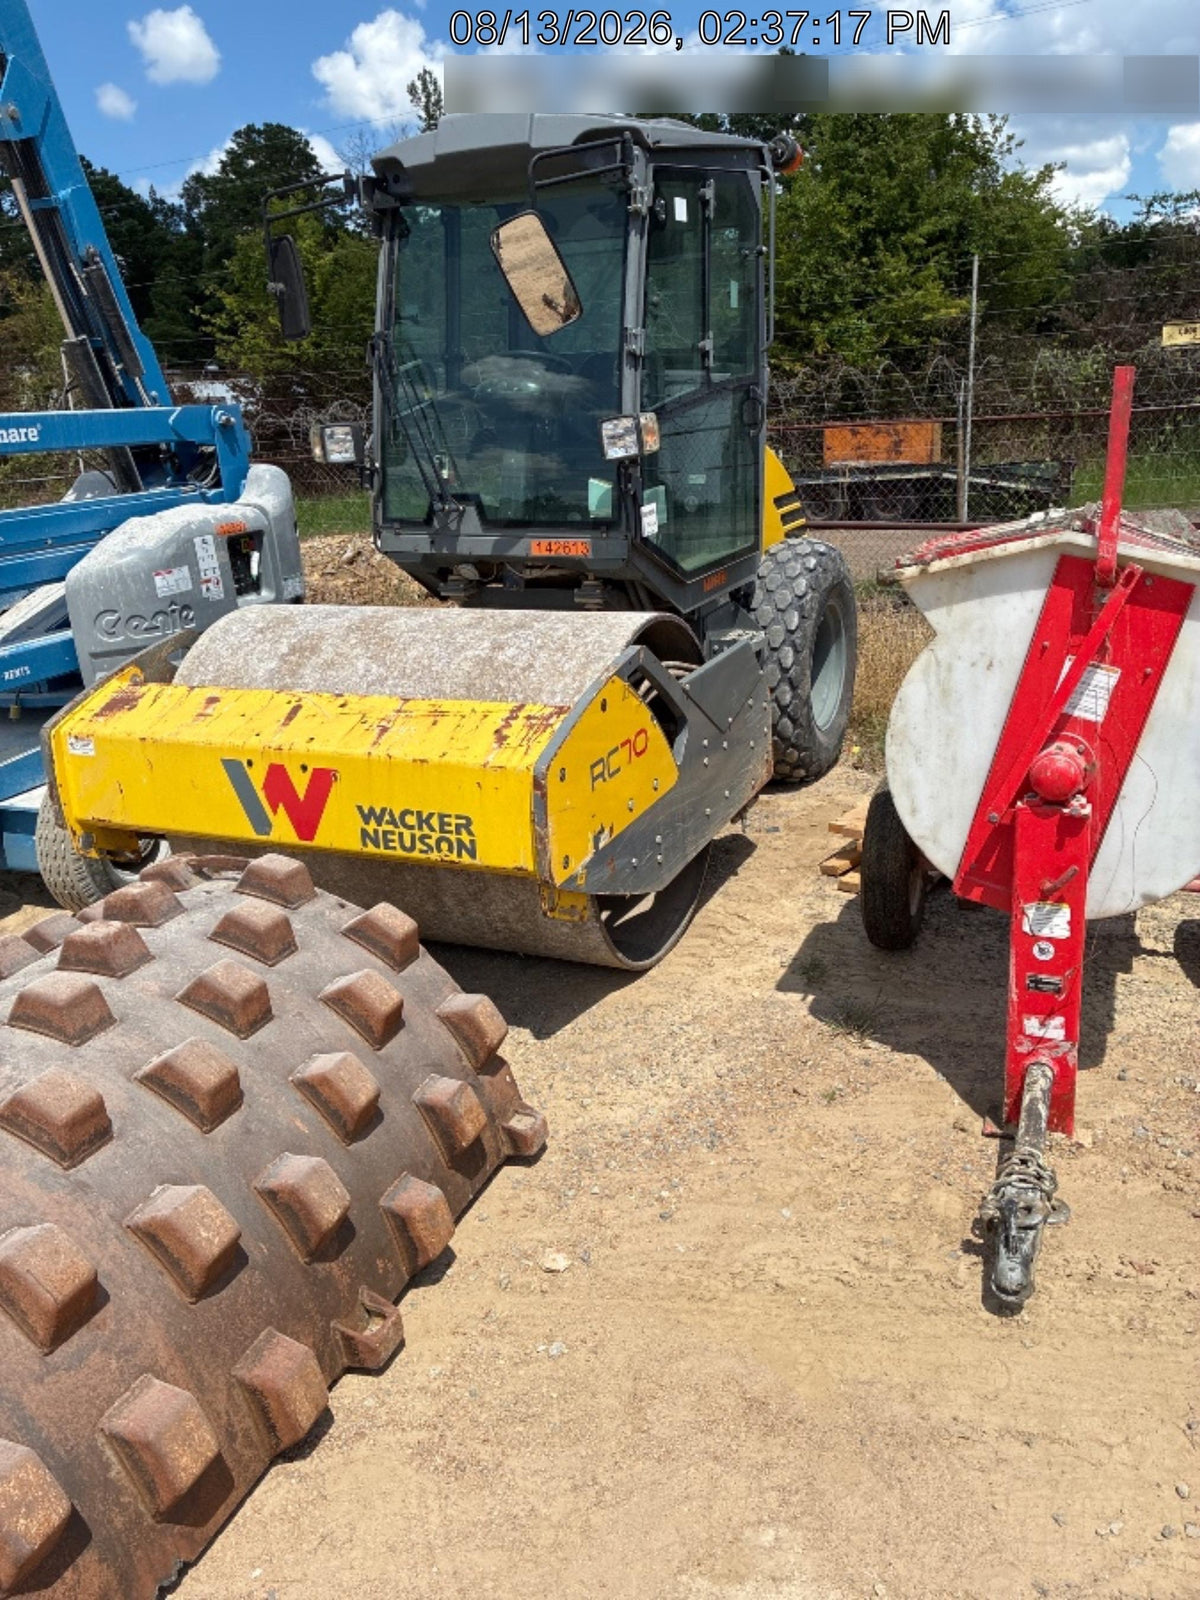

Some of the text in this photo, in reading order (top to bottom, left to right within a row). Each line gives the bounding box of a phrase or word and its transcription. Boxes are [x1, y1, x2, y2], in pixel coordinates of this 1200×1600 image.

[93, 600, 196, 642] Genie
[589, 728, 649, 792] RC70
[355, 804, 475, 838] WACKER
[360, 827, 478, 860] NEUSON
